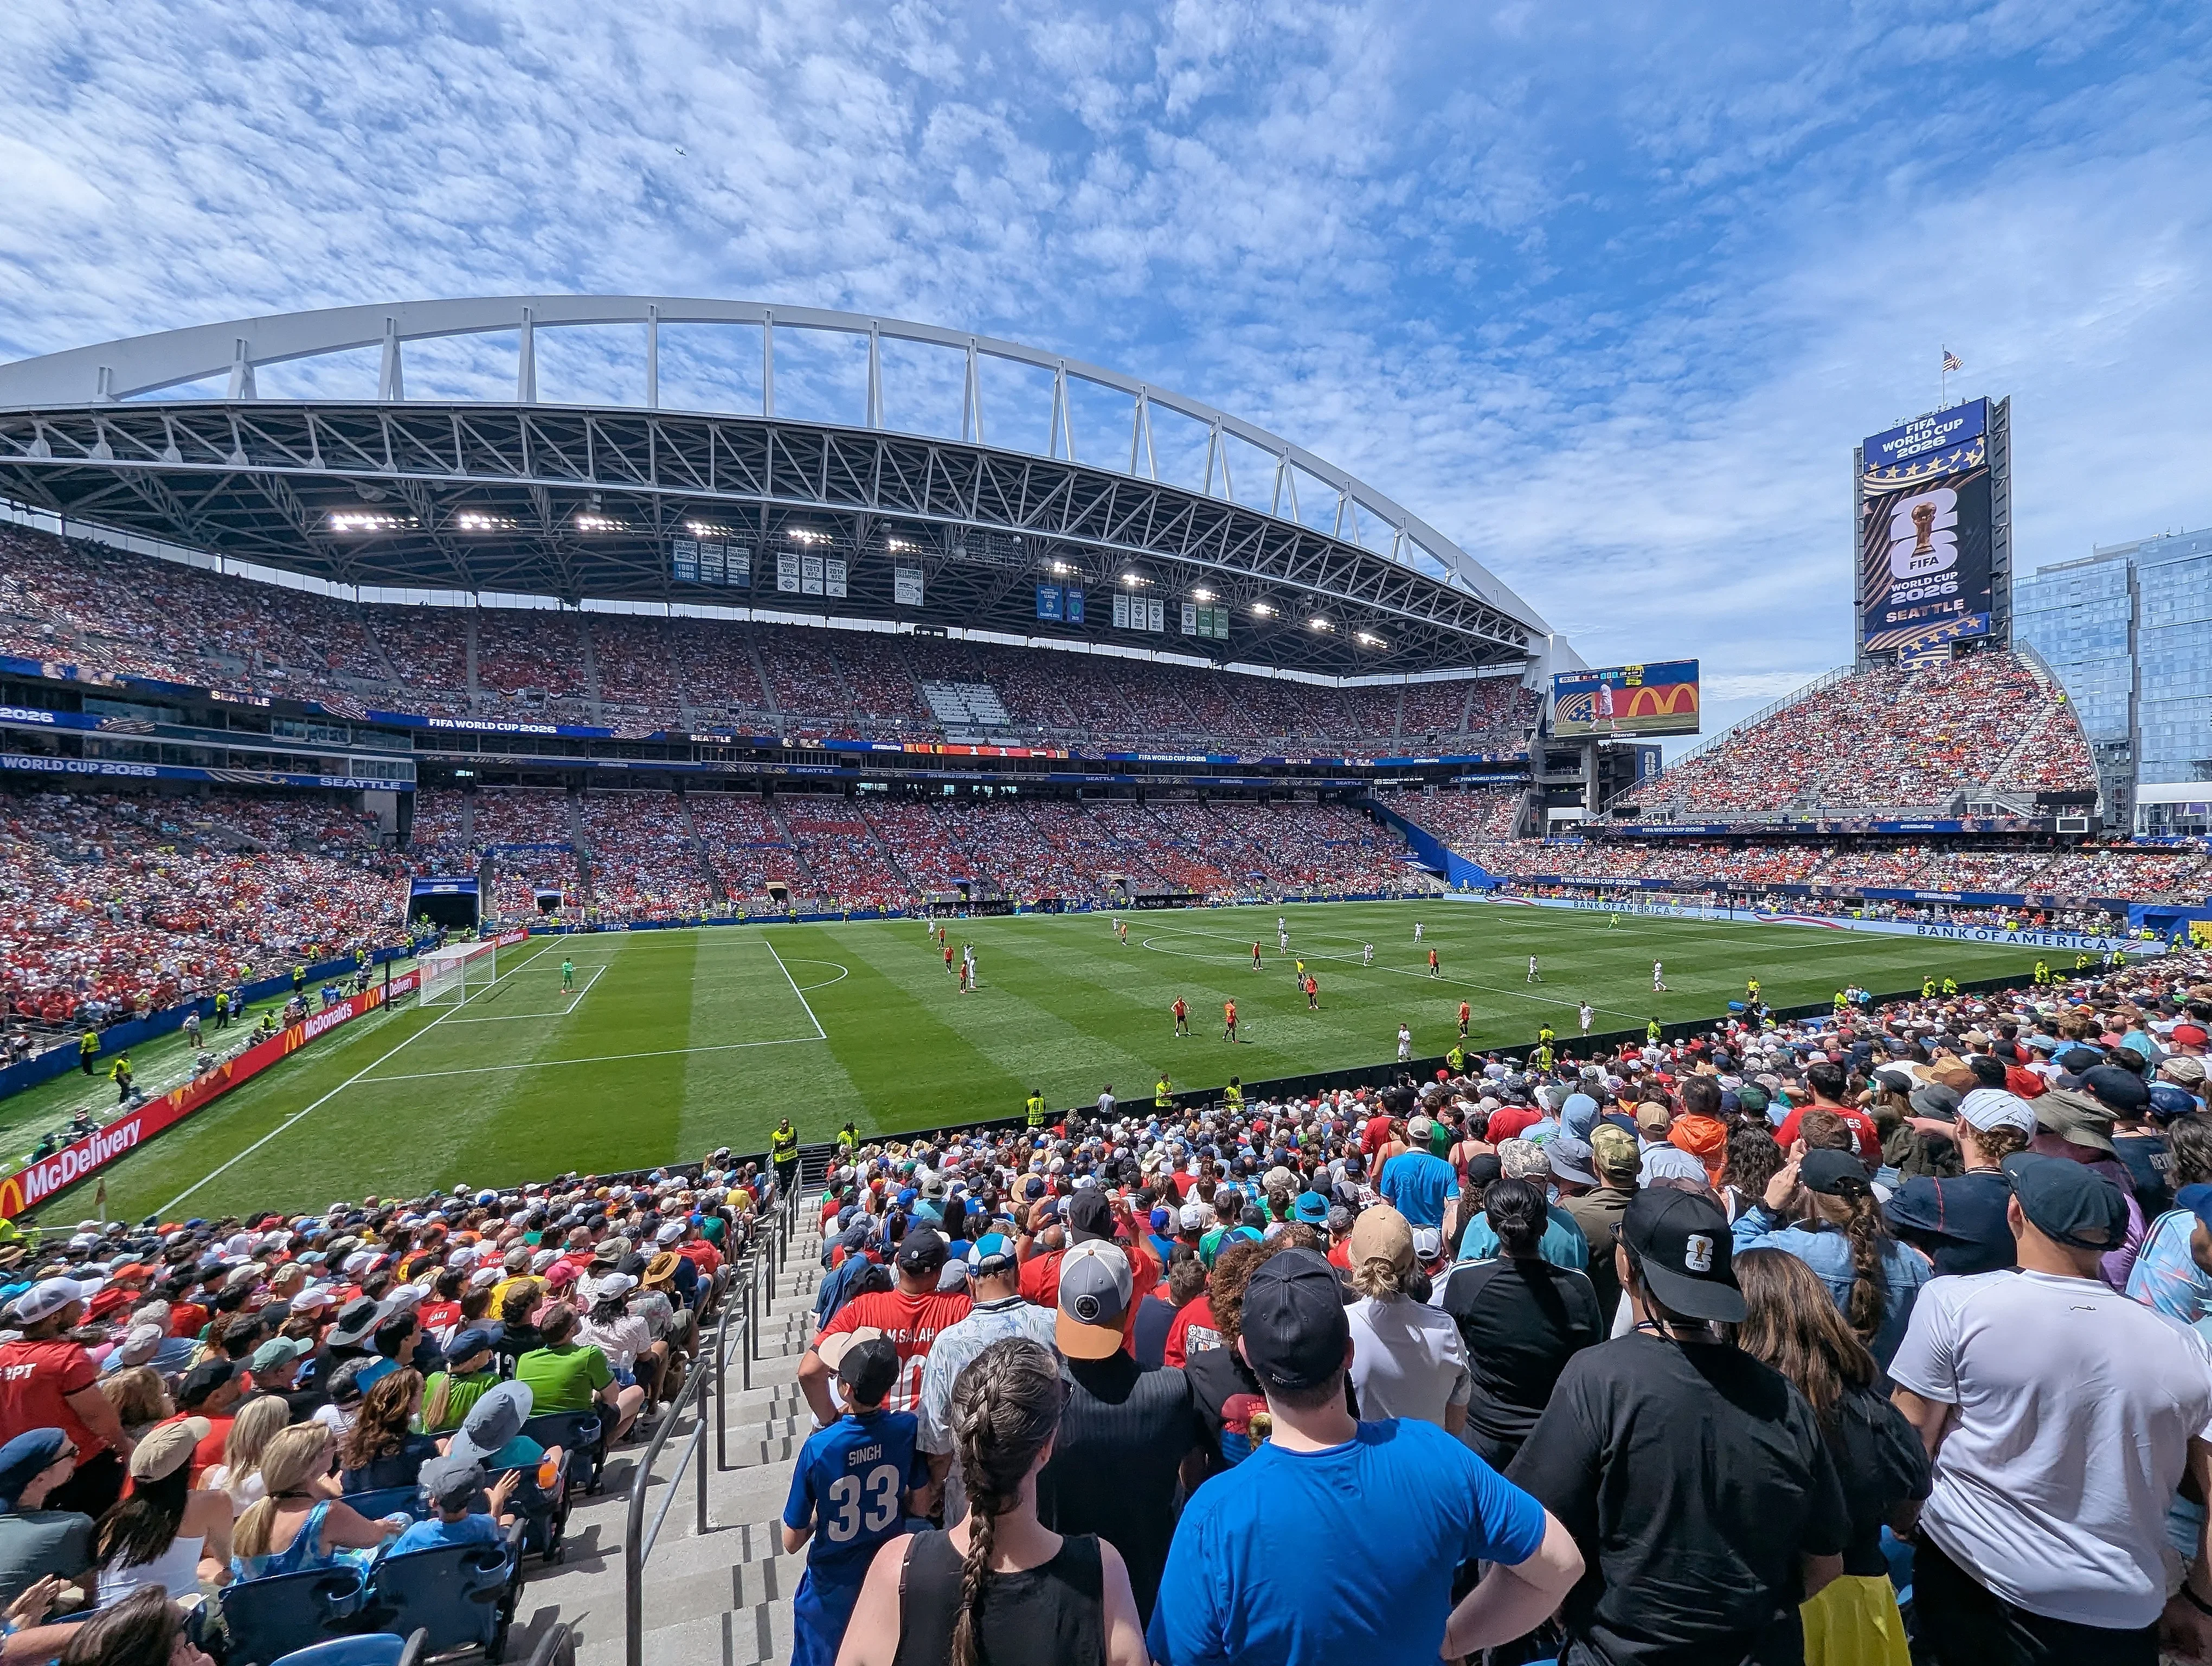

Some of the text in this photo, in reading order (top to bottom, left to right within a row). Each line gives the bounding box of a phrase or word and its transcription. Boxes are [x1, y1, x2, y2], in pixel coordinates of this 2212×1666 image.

[1906, 418, 1936, 434] FIFA
[1882, 418, 1964, 452] WORLD CUP
[1896, 435, 1946, 459] 2026
[1909, 556, 1939, 571] FIFA
[1891, 571, 1959, 592] WORLD CUP
[1891, 581, 1959, 605] 2026
[1886, 598, 1964, 623] SEATTLE
[210, 690, 270, 707] SEATTLE
[0, 707, 55, 723] 2026
[429, 718, 557, 734] FIFA WORLD CUP 2026
[690, 734, 731, 743] SEATTLE
[2, 757, 157, 777] WORLD CUP 2026
[320, 778, 401, 790] SEATTLE
[1727, 883, 1767, 892] SEATTLE
[1914, 892, 1962, 901] #FIFAWorldCup
[1573, 901, 1671, 915] BANK OF AMERICA
[499, 932, 523, 946] McDelivery
[1917, 925, 2111, 950] BANK OF AMERICA
[380, 978, 413, 1002] MDelivery
[305, 1002, 352, 1040] McDonald's
[1649, 1053, 1656, 1062] 10
[1844, 1118, 1862, 1129] ES
[25, 1119, 141, 1204] McDelivery
[1316, 1230, 1327, 1242] ER
[429, 1311, 448, 1323] SAKA
[886, 1327, 935, 1343] M.SALAH
[848, 1443, 882, 1466] SINGH
[828, 1464, 900, 1542] 33
